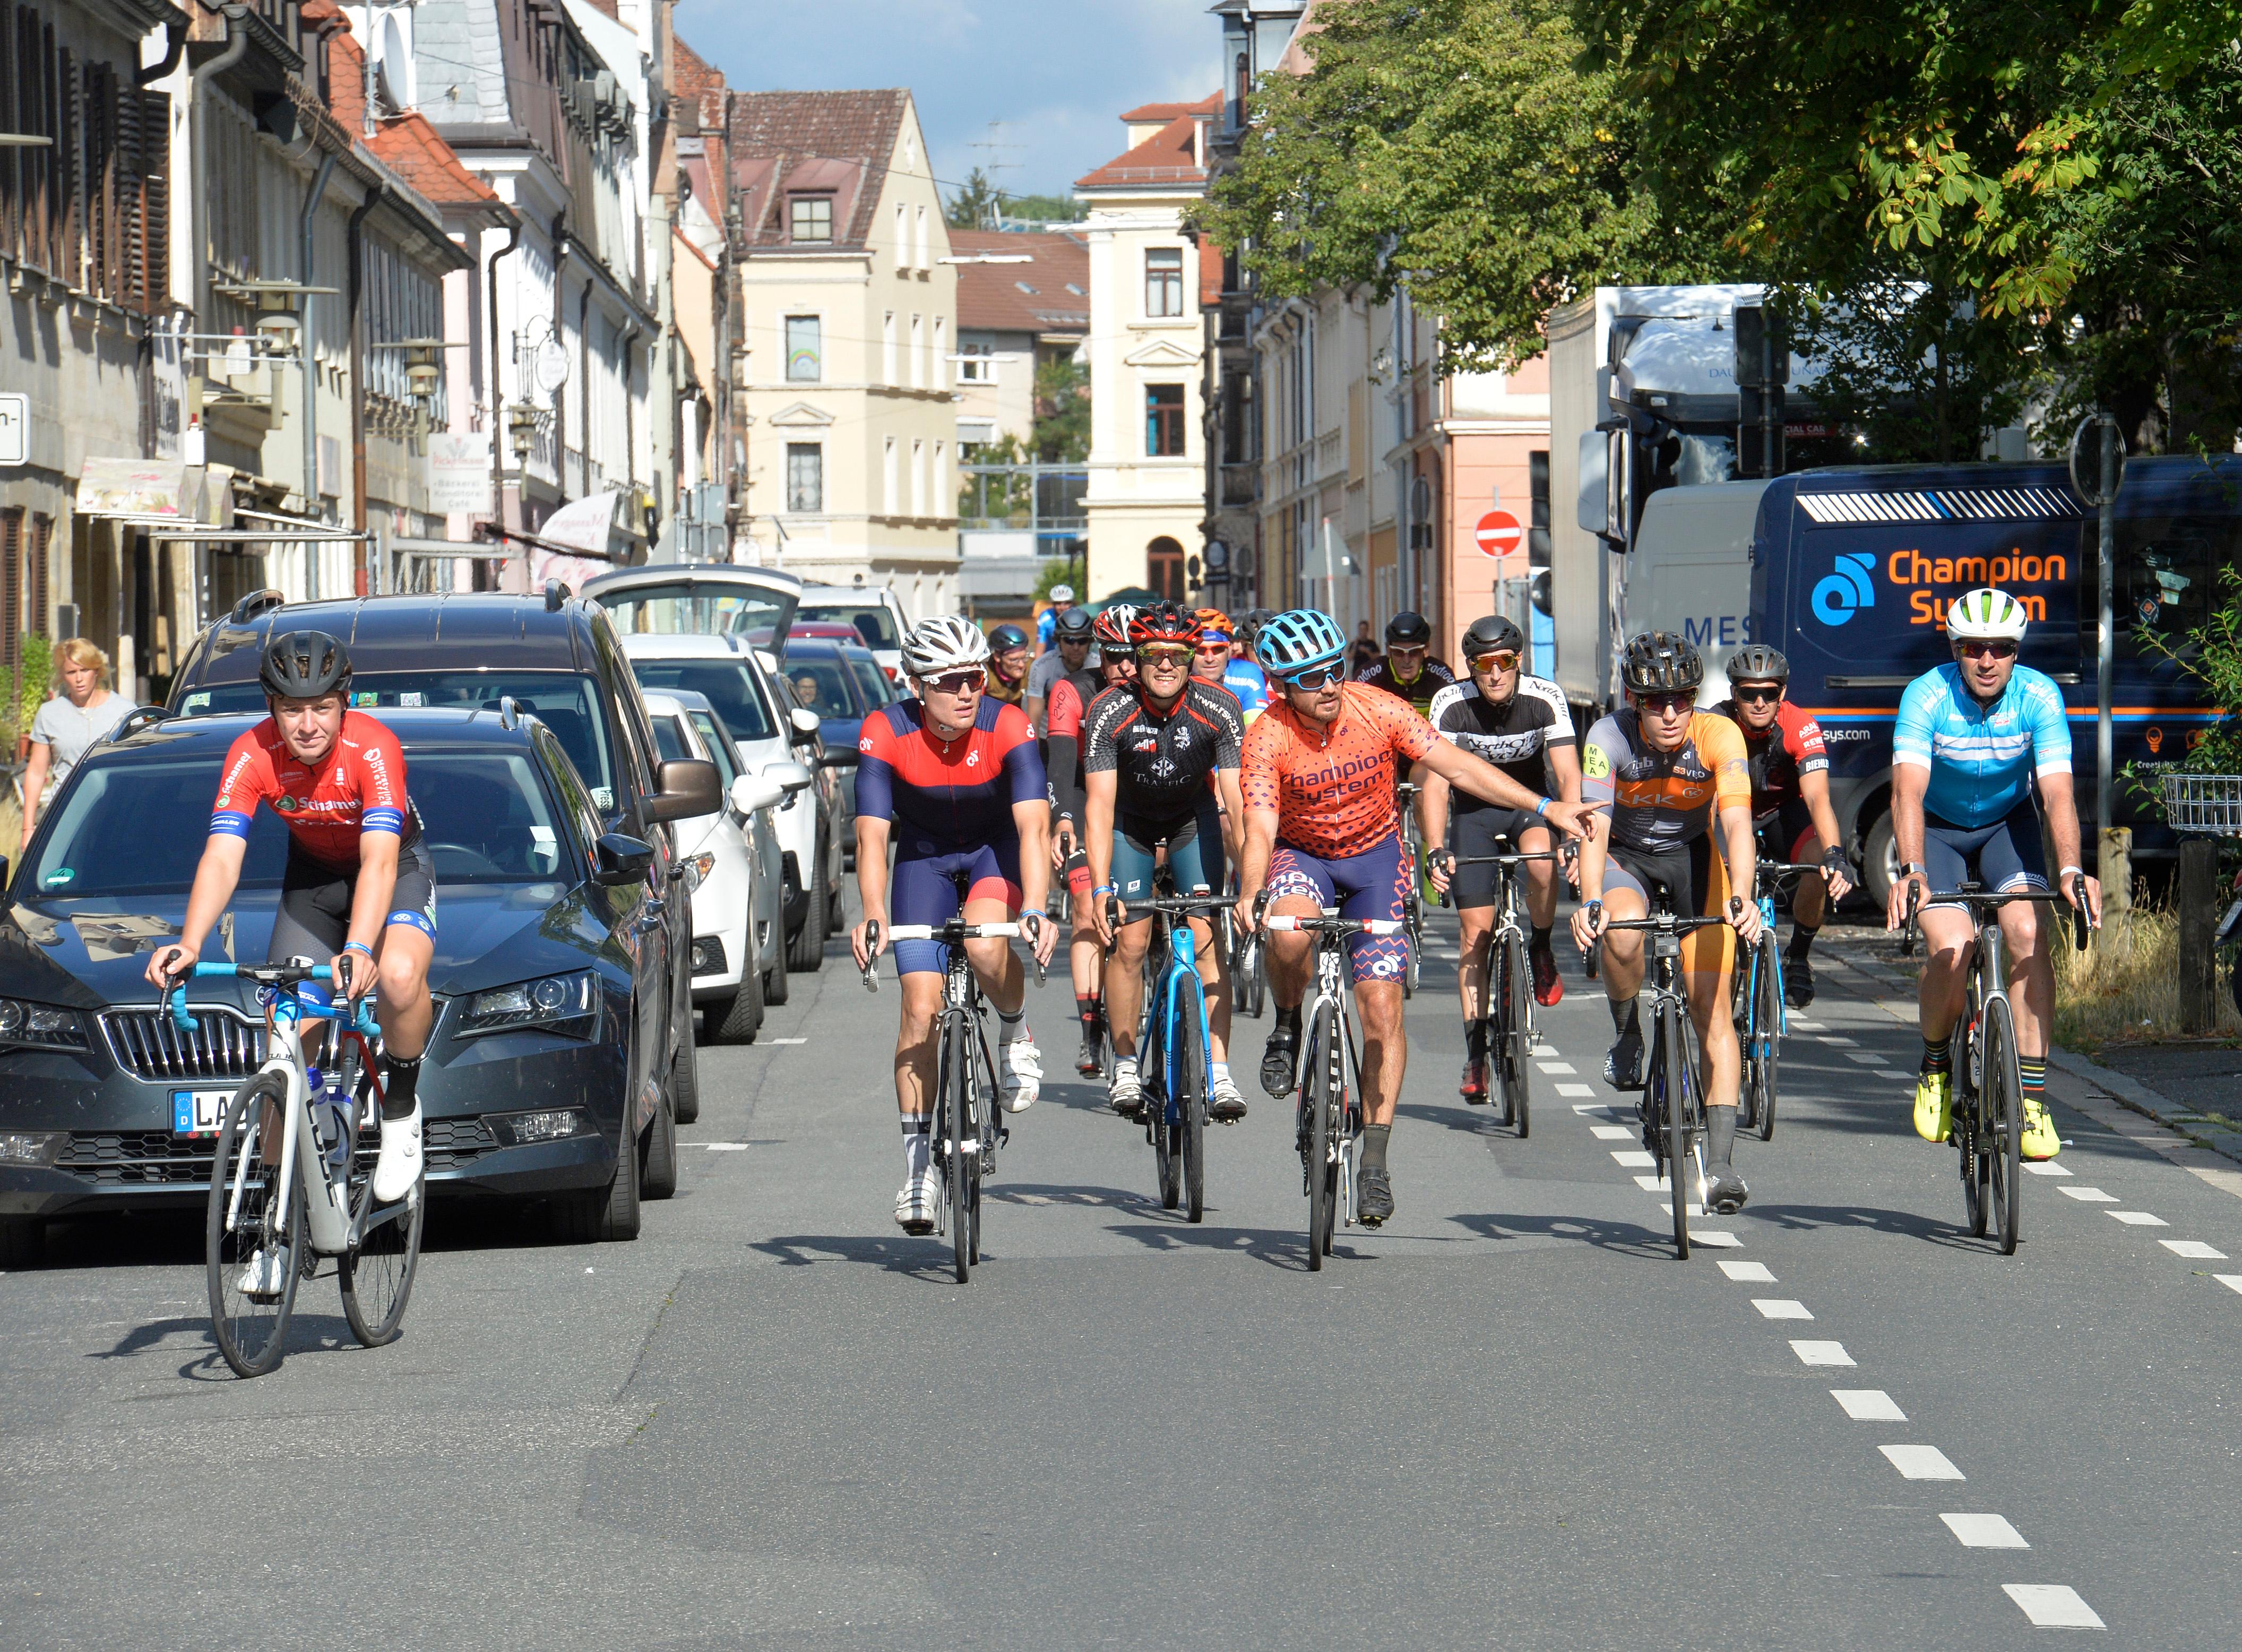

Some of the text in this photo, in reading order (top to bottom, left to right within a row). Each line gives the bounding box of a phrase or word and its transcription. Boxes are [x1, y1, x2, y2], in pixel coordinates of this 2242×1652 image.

[1889, 547, 2066, 589] Champion
[1910, 590, 2046, 631] Sym
[1355, 664, 1382, 683] adroo
[1529, 681, 1568, 718] NorthCliff
[1088, 694, 1134, 758] www.rsv-23.de
[1799, 721, 1819, 738] ARAL
[1467, 732, 1538, 751] NorthCliff
[221, 751, 252, 794] Schamel
[1133, 771, 1192, 787] TRAFIC
[1290, 770, 1383, 803] System
[298, 797, 363, 812] Schamel
[1616, 789, 1676, 806] LKK
[180, 1116, 189, 1125] D
